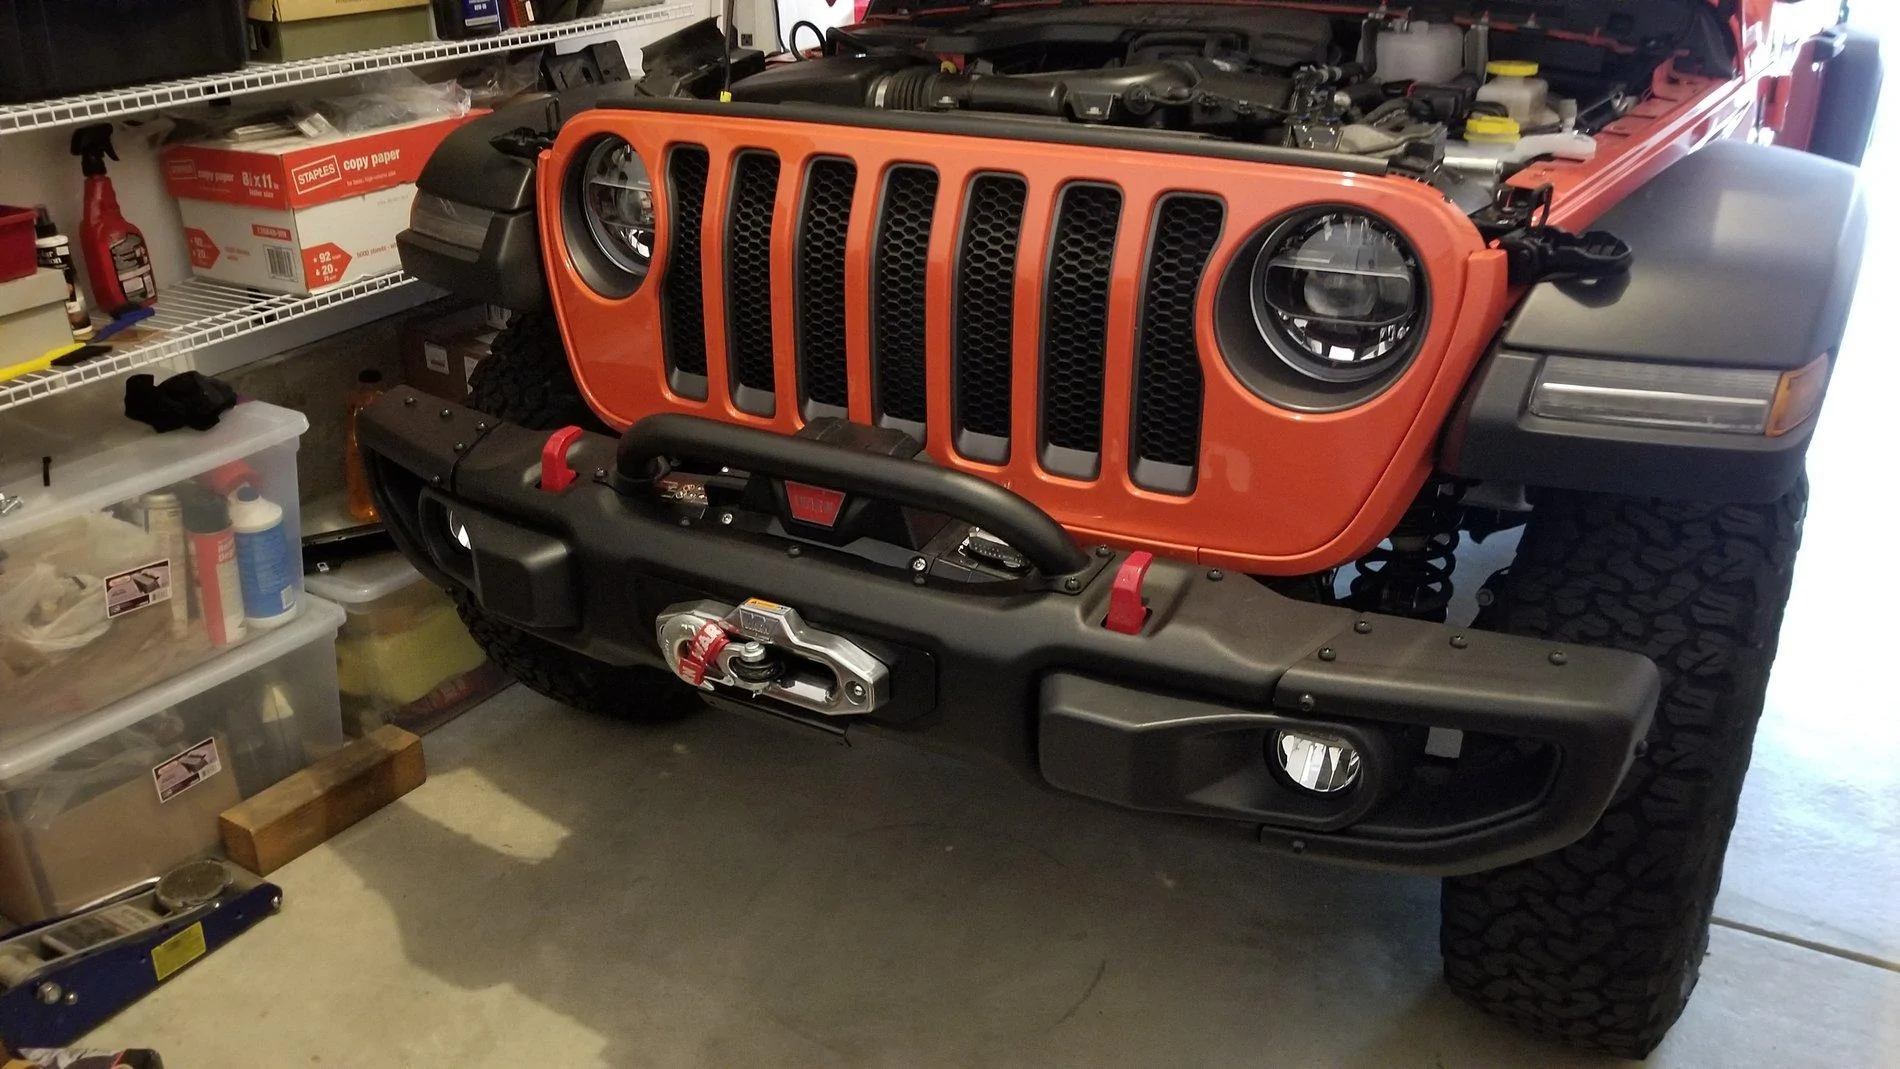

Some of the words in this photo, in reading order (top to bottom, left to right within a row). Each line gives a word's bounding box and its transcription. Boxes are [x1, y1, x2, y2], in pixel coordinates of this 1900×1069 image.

[344, 156, 369, 173] copy
[371, 148, 400, 167] paper
[297, 162, 336, 185] STAPLES
[319, 251, 332, 263] 92
[321, 263, 334, 276] 20
